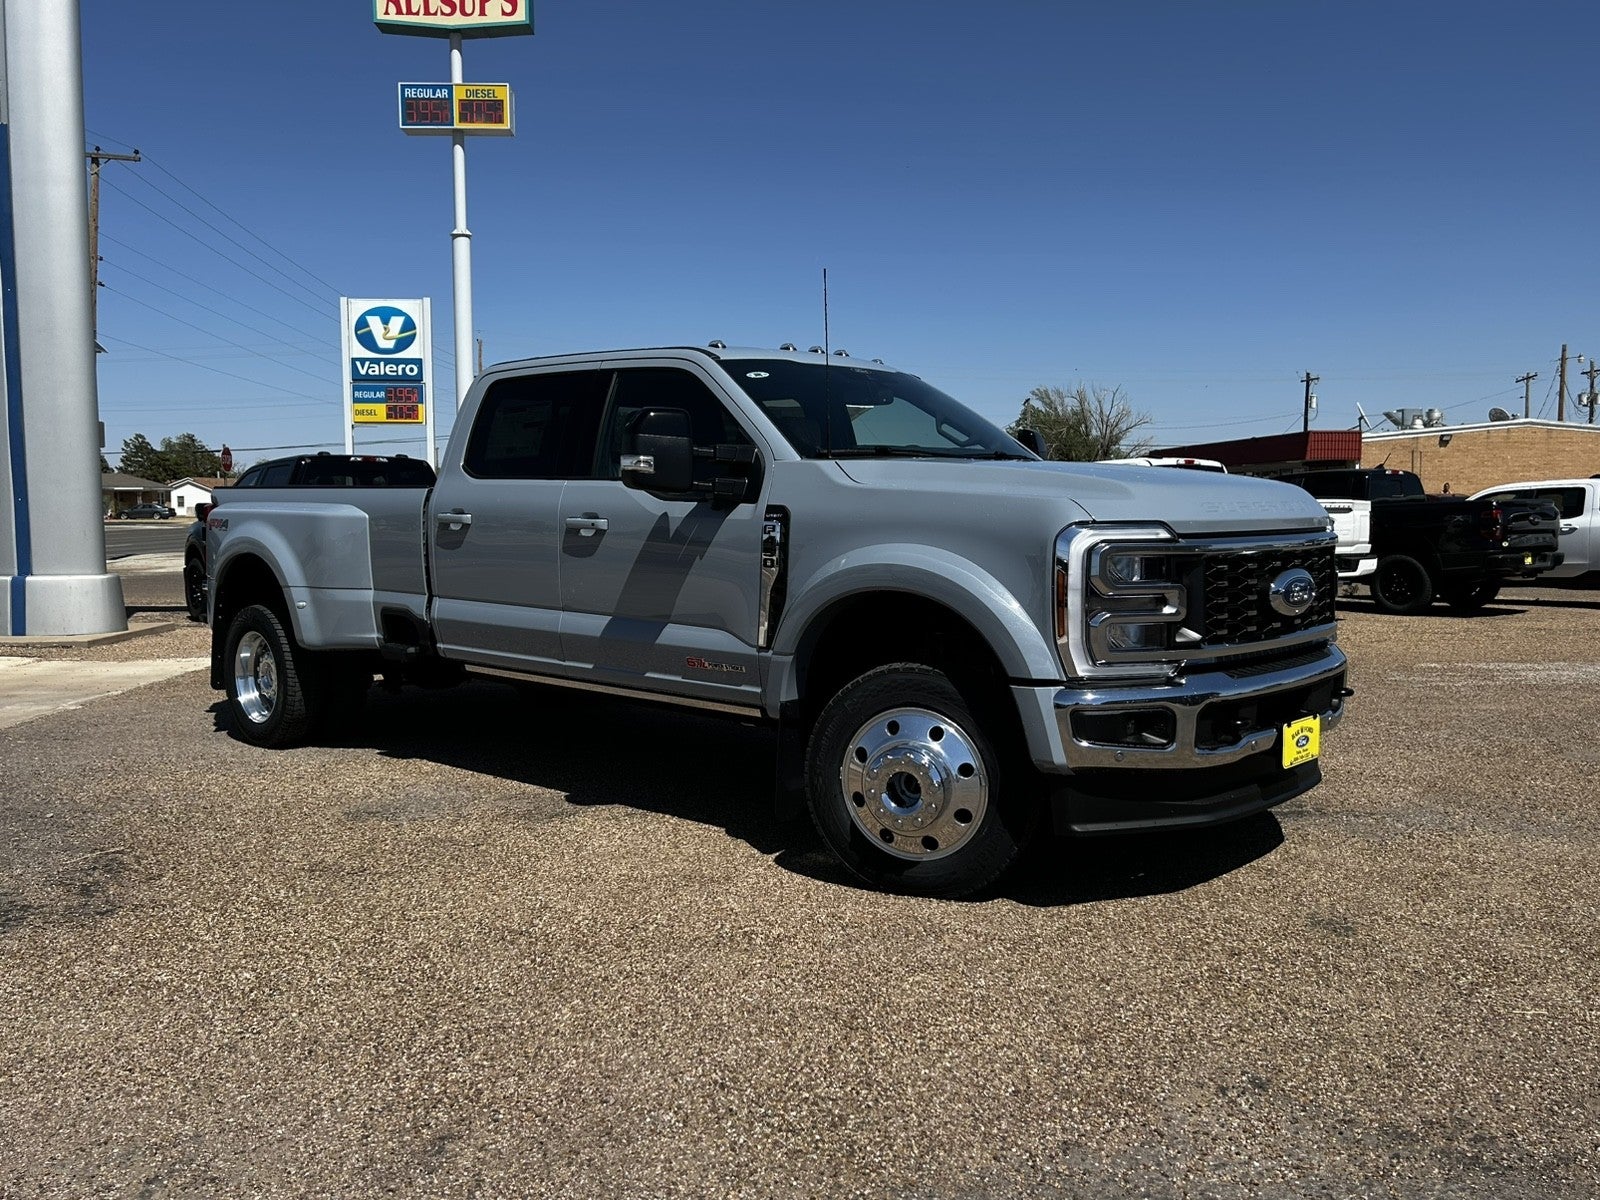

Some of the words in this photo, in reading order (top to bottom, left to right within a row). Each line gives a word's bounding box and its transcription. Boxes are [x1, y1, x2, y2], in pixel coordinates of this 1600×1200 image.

[383, 0, 518, 17] ALLSUPS
[404, 88, 449, 99] REGULAR
[465, 89, 498, 99] DIESEL
[355, 361, 418, 376] Valero
[354, 391, 385, 399] REGULAR
[355, 408, 378, 416] DIESEL
[222, 454, 232, 465] STOP
